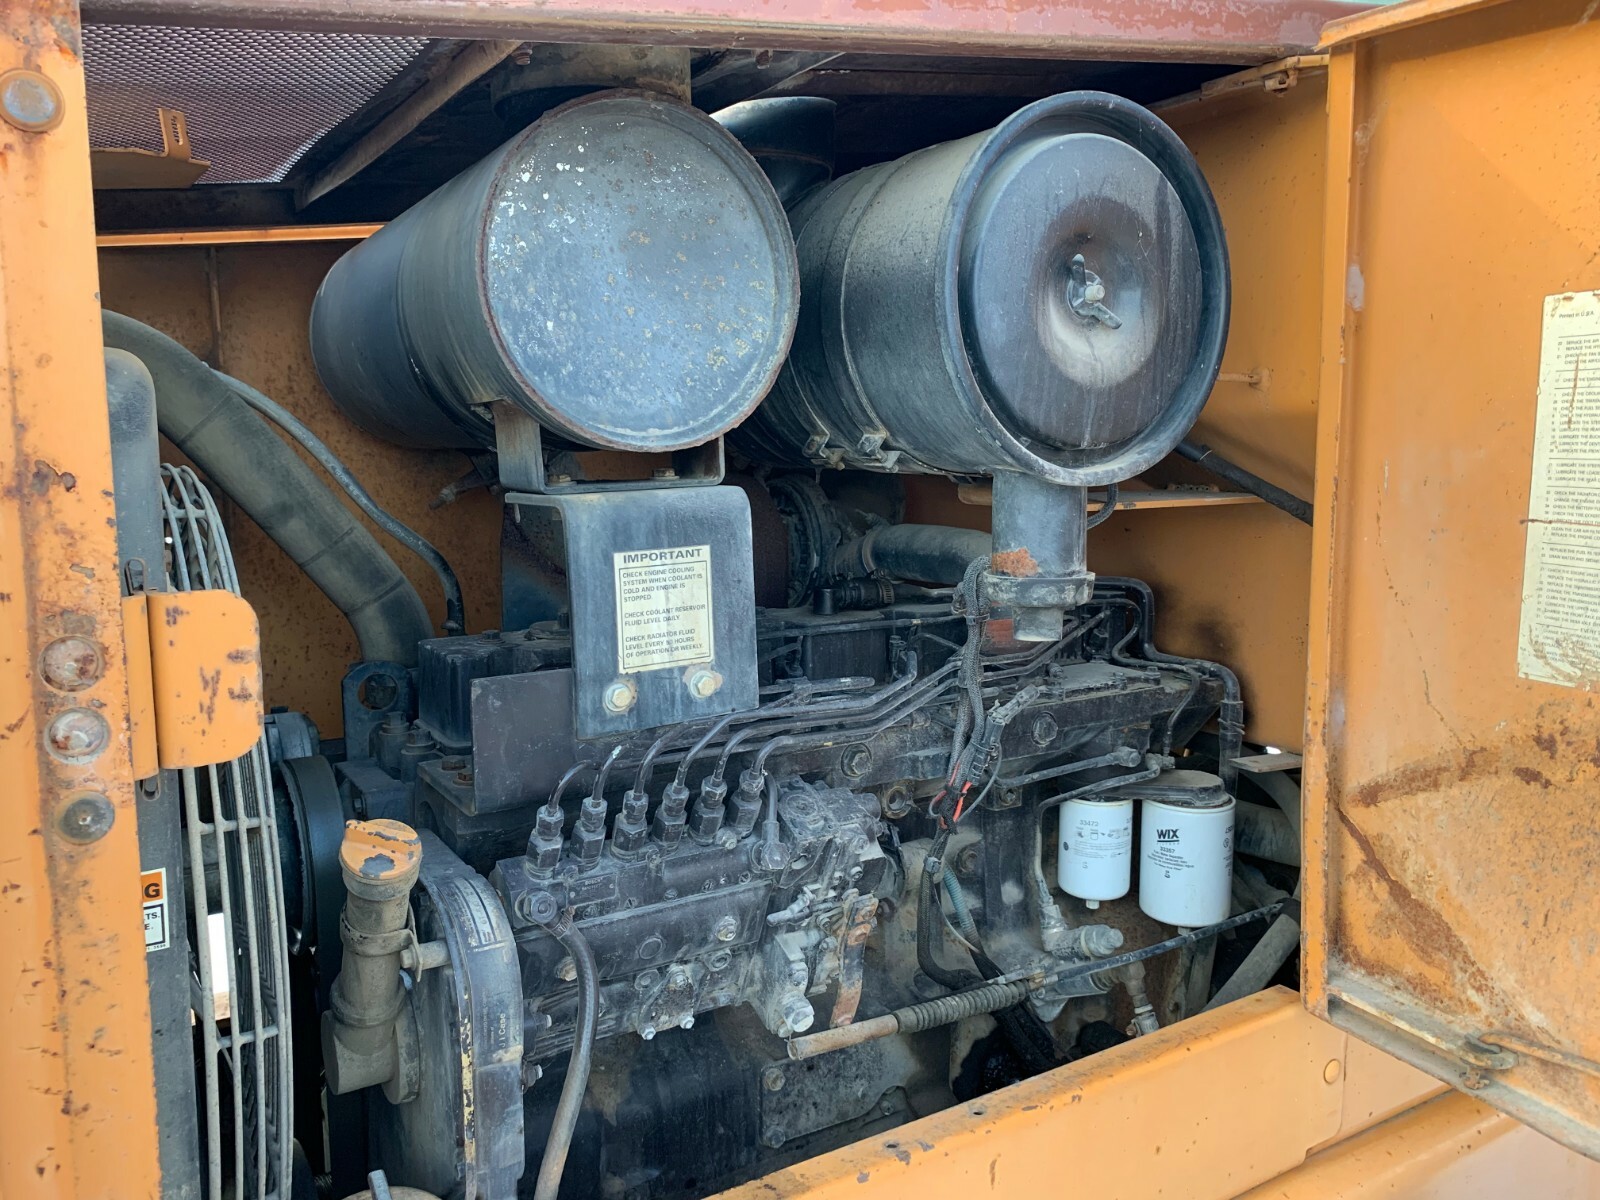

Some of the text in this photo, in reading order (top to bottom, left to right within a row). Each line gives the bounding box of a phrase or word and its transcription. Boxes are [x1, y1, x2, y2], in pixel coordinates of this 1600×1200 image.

[623, 548, 702, 563] IMPORTANT
[646, 608, 674, 616] COOLANT
[675, 604, 706, 612] RESERVOIR
[647, 631, 678, 639] RADIATOR
[636, 648, 669, 657] OPERATION
[1157, 829, 1179, 839] WIX
[144, 883, 160, 898] G
